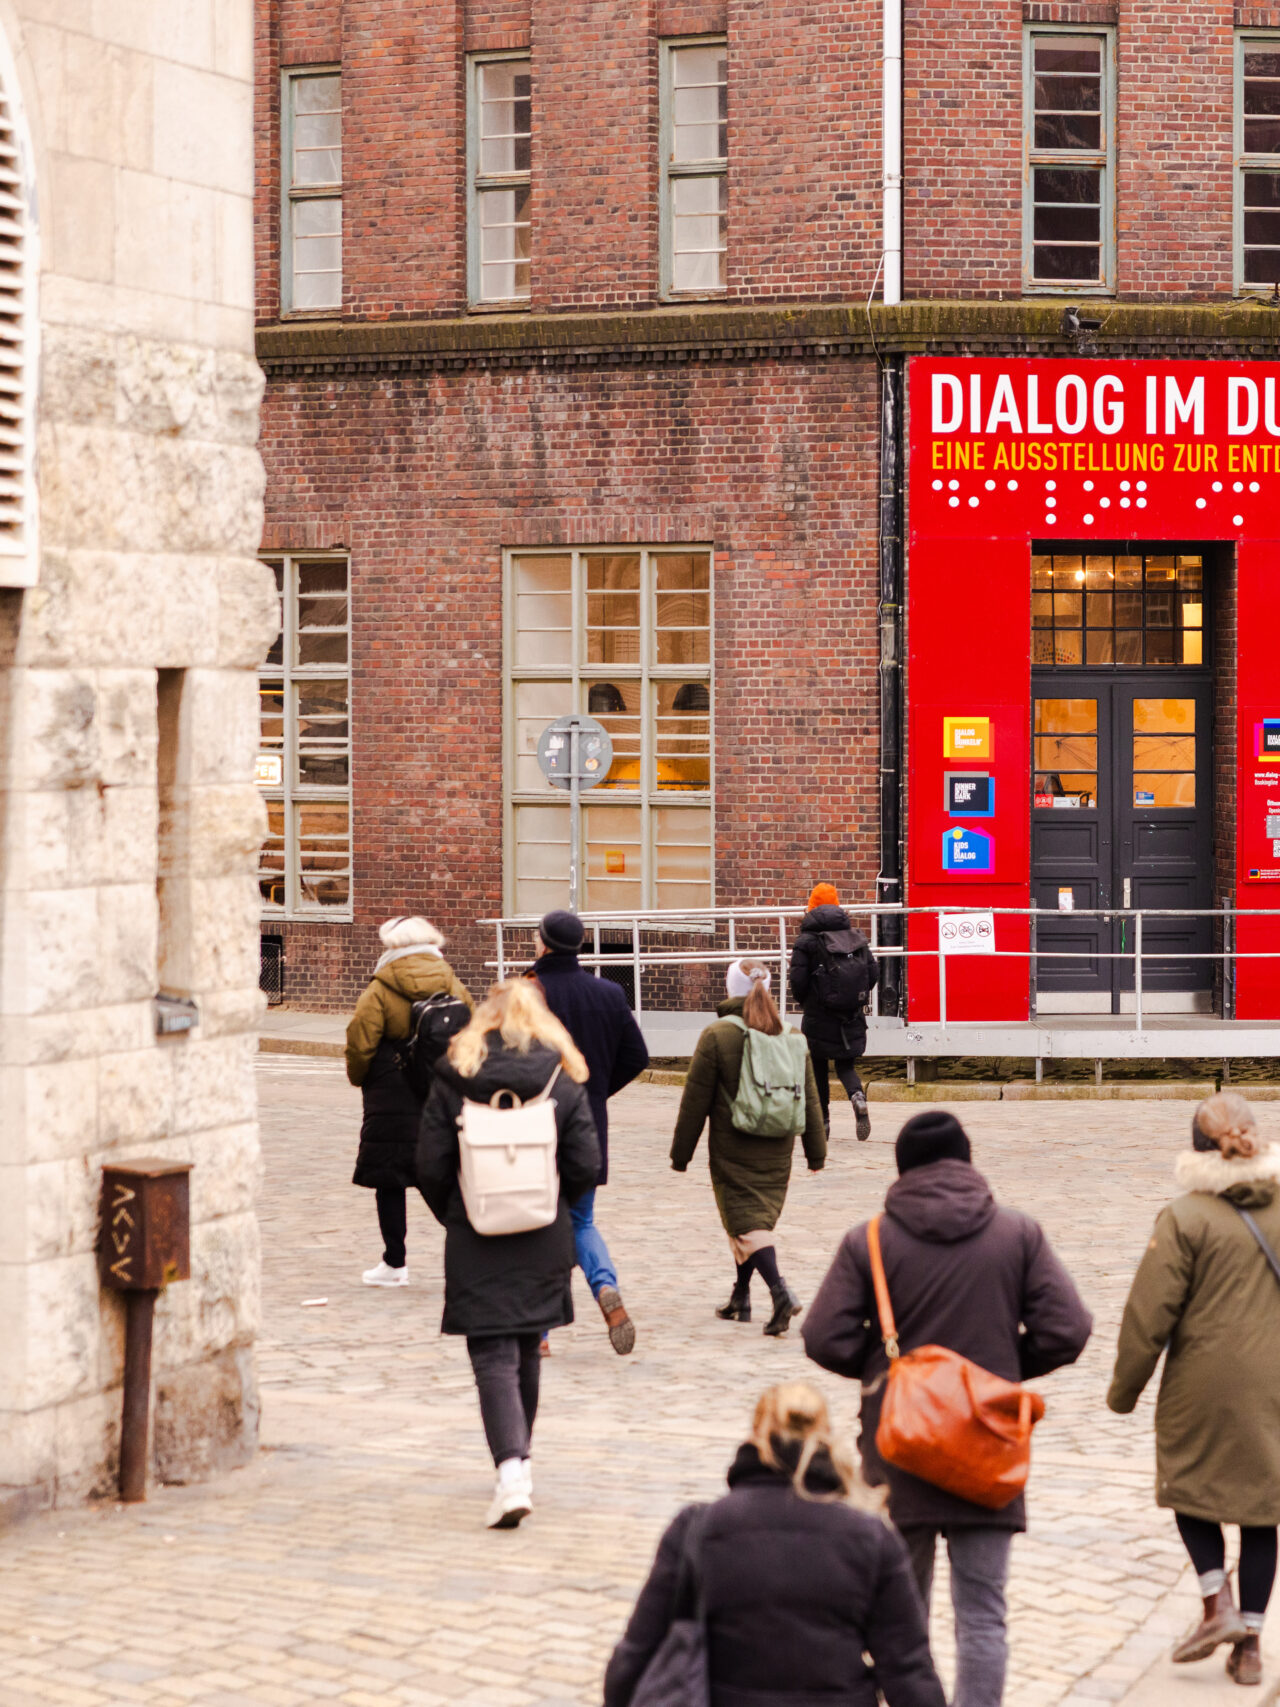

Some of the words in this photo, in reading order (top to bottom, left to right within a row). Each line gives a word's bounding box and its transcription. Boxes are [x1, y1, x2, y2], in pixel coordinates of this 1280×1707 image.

[931, 373, 1125, 434] DIALOG
[1145, 375, 1205, 436] IM
[931, 442, 985, 470] EINE
[993, 442, 1165, 472] AUSSTELLUNG
[1173, 443, 1219, 472] ZUR
[954, 841, 969, 850] KIDS
[953, 852, 976, 860] DIALOG
